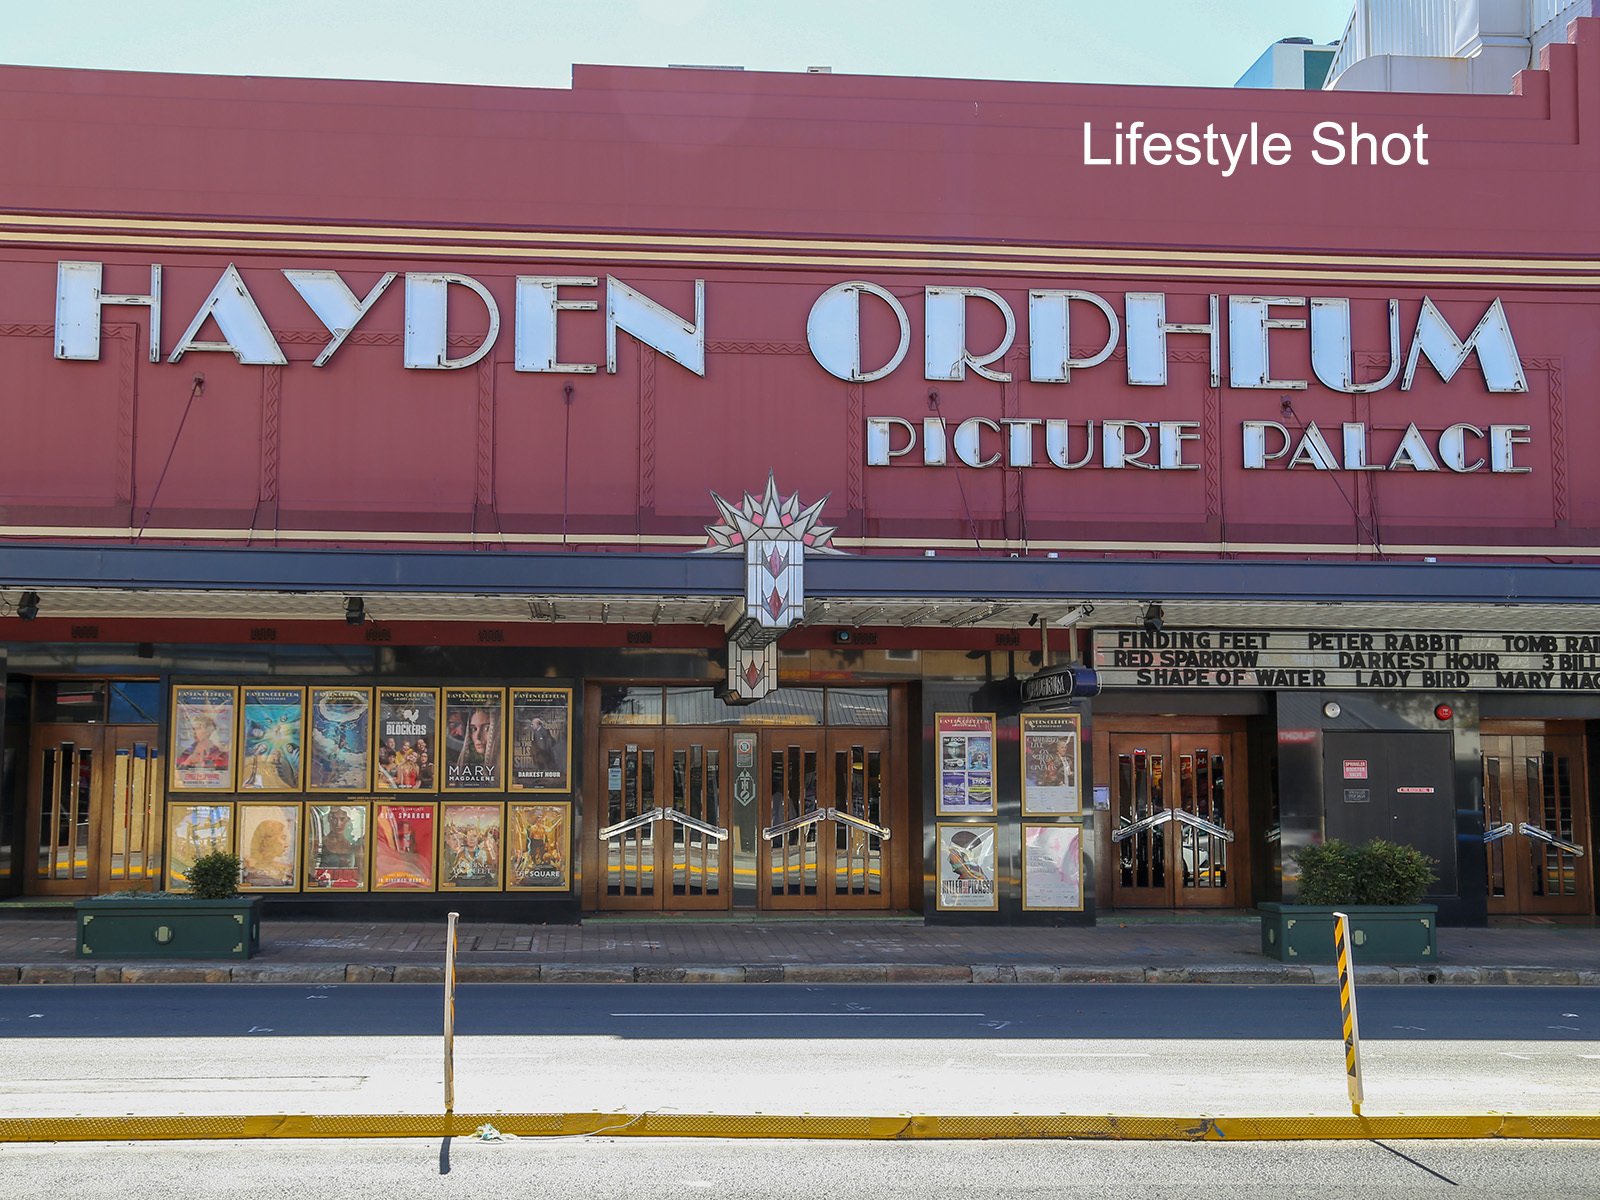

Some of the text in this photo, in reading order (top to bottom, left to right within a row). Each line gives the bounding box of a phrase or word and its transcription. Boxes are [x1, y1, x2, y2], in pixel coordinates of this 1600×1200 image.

[54, 260, 1529, 394] HAYDEN ORPHEUM
[866, 416, 1533, 474] PICTURE PALACE
[1118, 631, 1600, 653] FINDING FEET PETER RABBIT TOMB RAI
[1114, 650, 1154, 667] RED
[1160, 650, 1260, 668] SPARROW
[1338, 652, 1437, 669] DARKEST
[1446, 653, 1500, 670] HOUR
[1542, 654, 1554, 671] 3
[1136, 669, 1210, 687] SHAPE
[1216, 669, 1247, 687] OF
[1255, 669, 1327, 687] WATER
[1355, 670, 1411, 687] LADY
[1422, 670, 1470, 688] BIRD
[1496, 671, 1556, 689] MARY
[386, 724, 427, 735] BLOCKERS
[449, 766, 495, 776] MARY
[942, 879, 962, 894] HITLER
[968, 879, 994, 894] PICASSO
